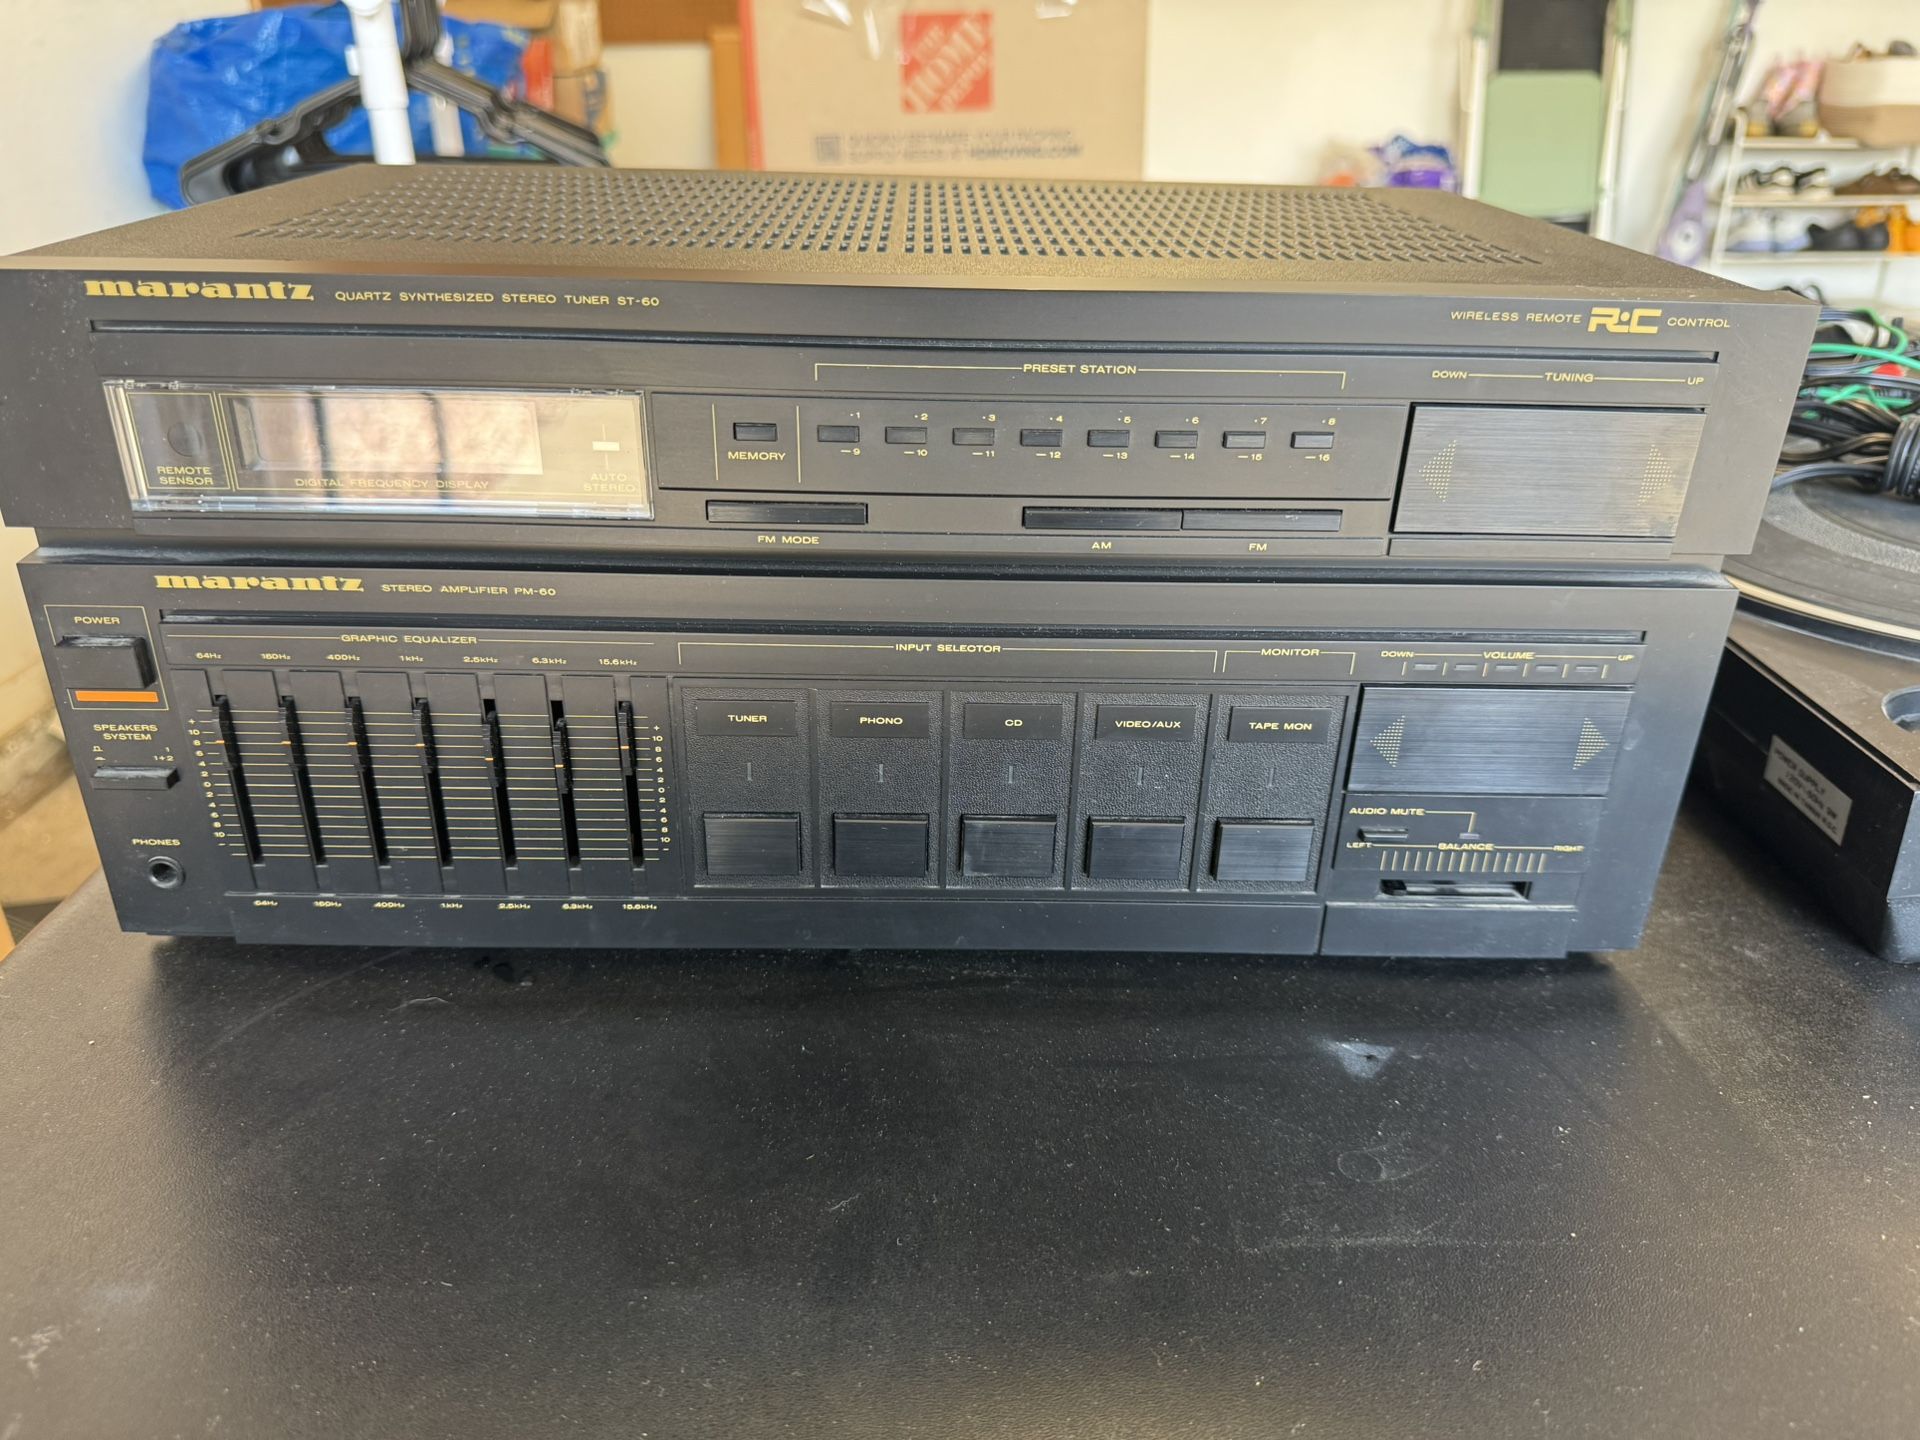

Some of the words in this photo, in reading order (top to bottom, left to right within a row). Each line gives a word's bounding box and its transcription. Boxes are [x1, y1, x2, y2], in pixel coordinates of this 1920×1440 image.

[84, 280, 314, 300] marantz
[334, 291, 392, 302] QUARTZ
[399, 291, 495, 303] SYNTHESIZED
[501, 293, 557, 304] STEREO
[563, 294, 610, 305] TUNER
[617, 295, 660, 307] ST-60
[1450, 310, 1520, 322] WIRELESS
[1525, 312, 1582, 324] REMOTE
[1667, 316, 1731, 328] CONTROL
[1023, 363, 1077, 374] PRESET
[1079, 364, 1137, 375] STATION
[1432, 370, 1467, 379] DOWN
[1544, 372, 1594, 384] TUNING
[1687, 376, 1704, 386] UP
[727, 451, 786, 461] MEMORY
[156, 465, 212, 475] REMOTE
[159, 476, 214, 486] SENSOR
[590, 472, 627, 482] AUTO
[294, 477, 342, 488] DIGITAL
[349, 478, 428, 489] FREQUENCY
[435, 479, 489, 490] DISPLAY
[583, 482, 636, 493] STEREO
[757, 535, 776, 544] FM
[781, 535, 820, 545] MODE
[1091, 541, 1112, 550] AM
[1248, 542, 1268, 551] FM
[153, 575, 364, 592] marantz
[381, 583, 433, 593] STEREO
[440, 585, 509, 595] AMPLIFIER
[514, 587, 557, 596] PM-60
[73, 616, 121, 625] POWER
[341, 634, 398, 644] GRAPHIC
[404, 635, 477, 646] EQUALIZER
[895, 643, 932, 652] INPUT
[937, 643, 1000, 654] SELECTOR
[1260, 648, 1320, 658] MONITOR
[326, 653, 361, 661] 400Hz
[463, 655, 499, 663] 2.5kHz
[1381, 649, 1414, 658] DOWN
[1483, 650, 1535, 661] VOLUME
[1617, 654, 1634, 662] UP
[531, 657, 567, 665] 6.3kHz
[599, 658, 637, 666] 15.6kHz
[727, 714, 768, 723] TUNER
[859, 716, 903, 725] PHONO
[1004, 719, 1023, 727] CD
[93, 723, 158, 732] SPEAKERS
[1114, 720, 1182, 729] VIDEO/AUX
[1248, 722, 1280, 730] TAPE
[1283, 722, 1313, 731] MON
[102, 732, 152, 741] SYSTEM
[1349, 807, 1388, 816] AUDIO
[1390, 808, 1424, 816] MUTE
[131, 838, 181, 846] PHONES
[1346, 841, 1371, 849] LEFT
[1438, 842, 1493, 852] BALANCE
[1552, 844, 1584, 853] RIGHT
